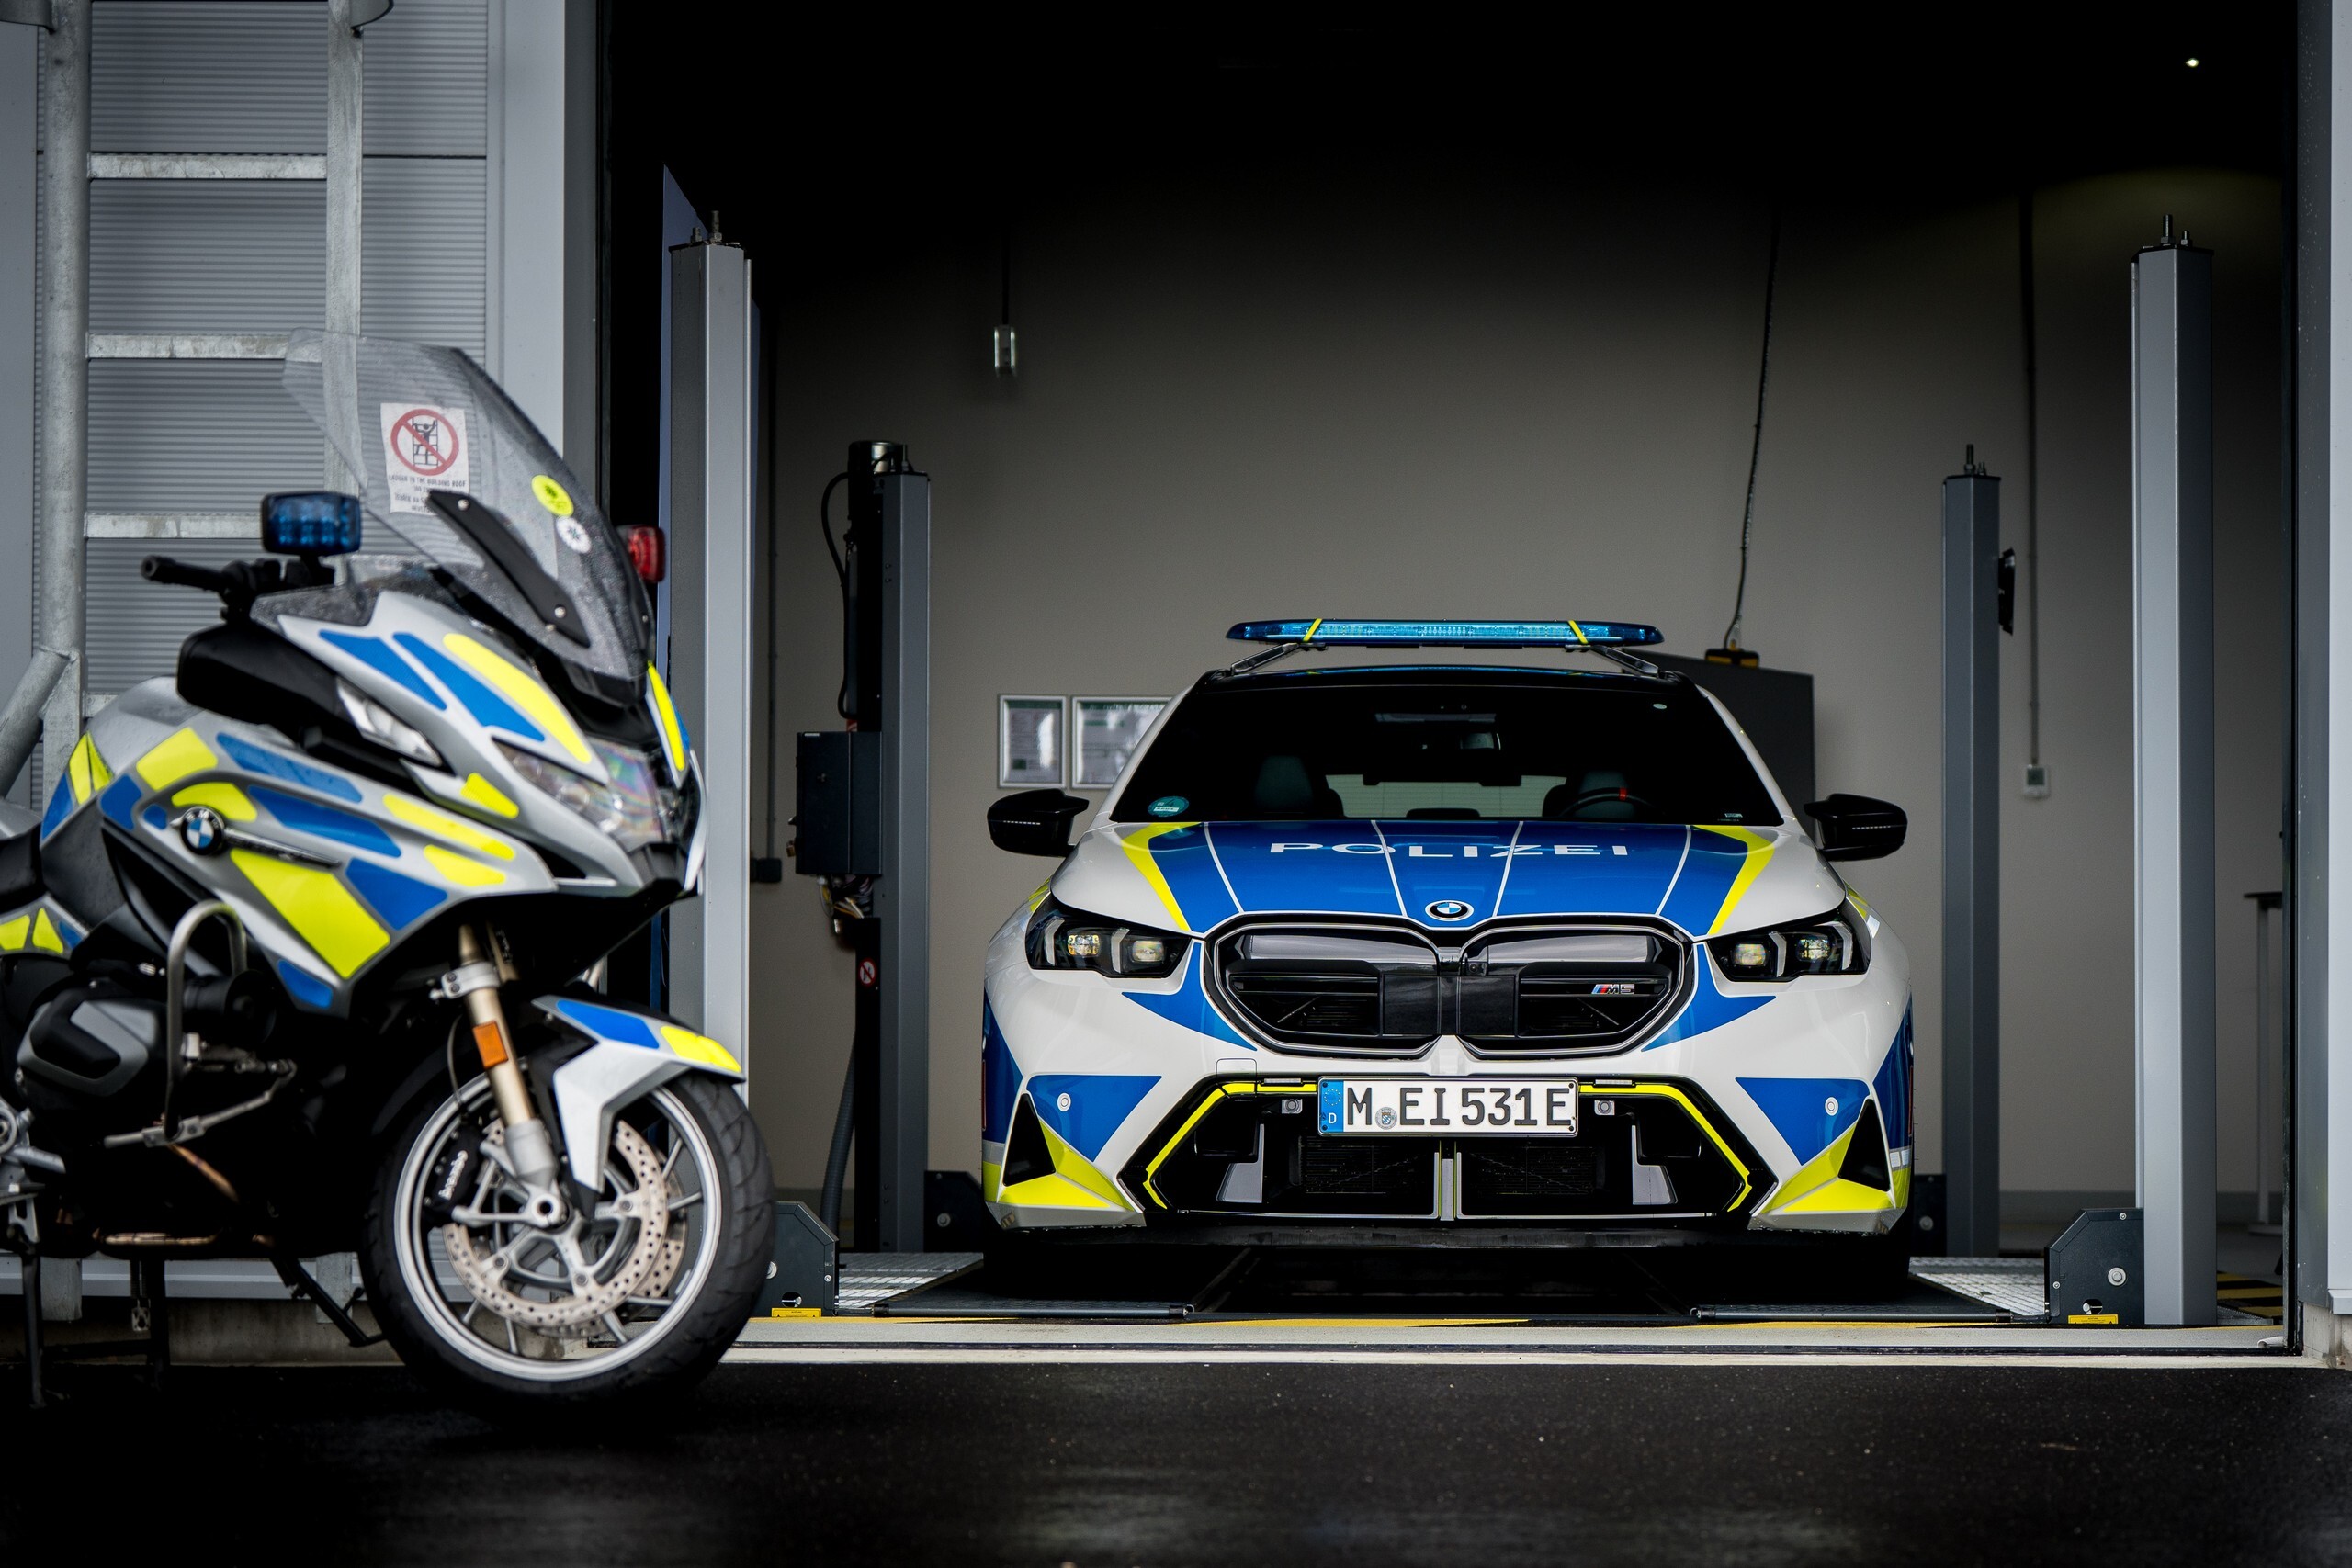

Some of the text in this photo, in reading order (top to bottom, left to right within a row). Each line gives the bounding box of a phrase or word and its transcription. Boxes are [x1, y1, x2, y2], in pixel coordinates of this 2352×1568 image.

[452, 479, 467, 488] ROOF
[1270, 842, 1628, 857] POLIZEI
[1592, 984, 1635, 995] M5
[1347, 1087, 1373, 1126] M
[1328, 1112, 1337, 1124] D
